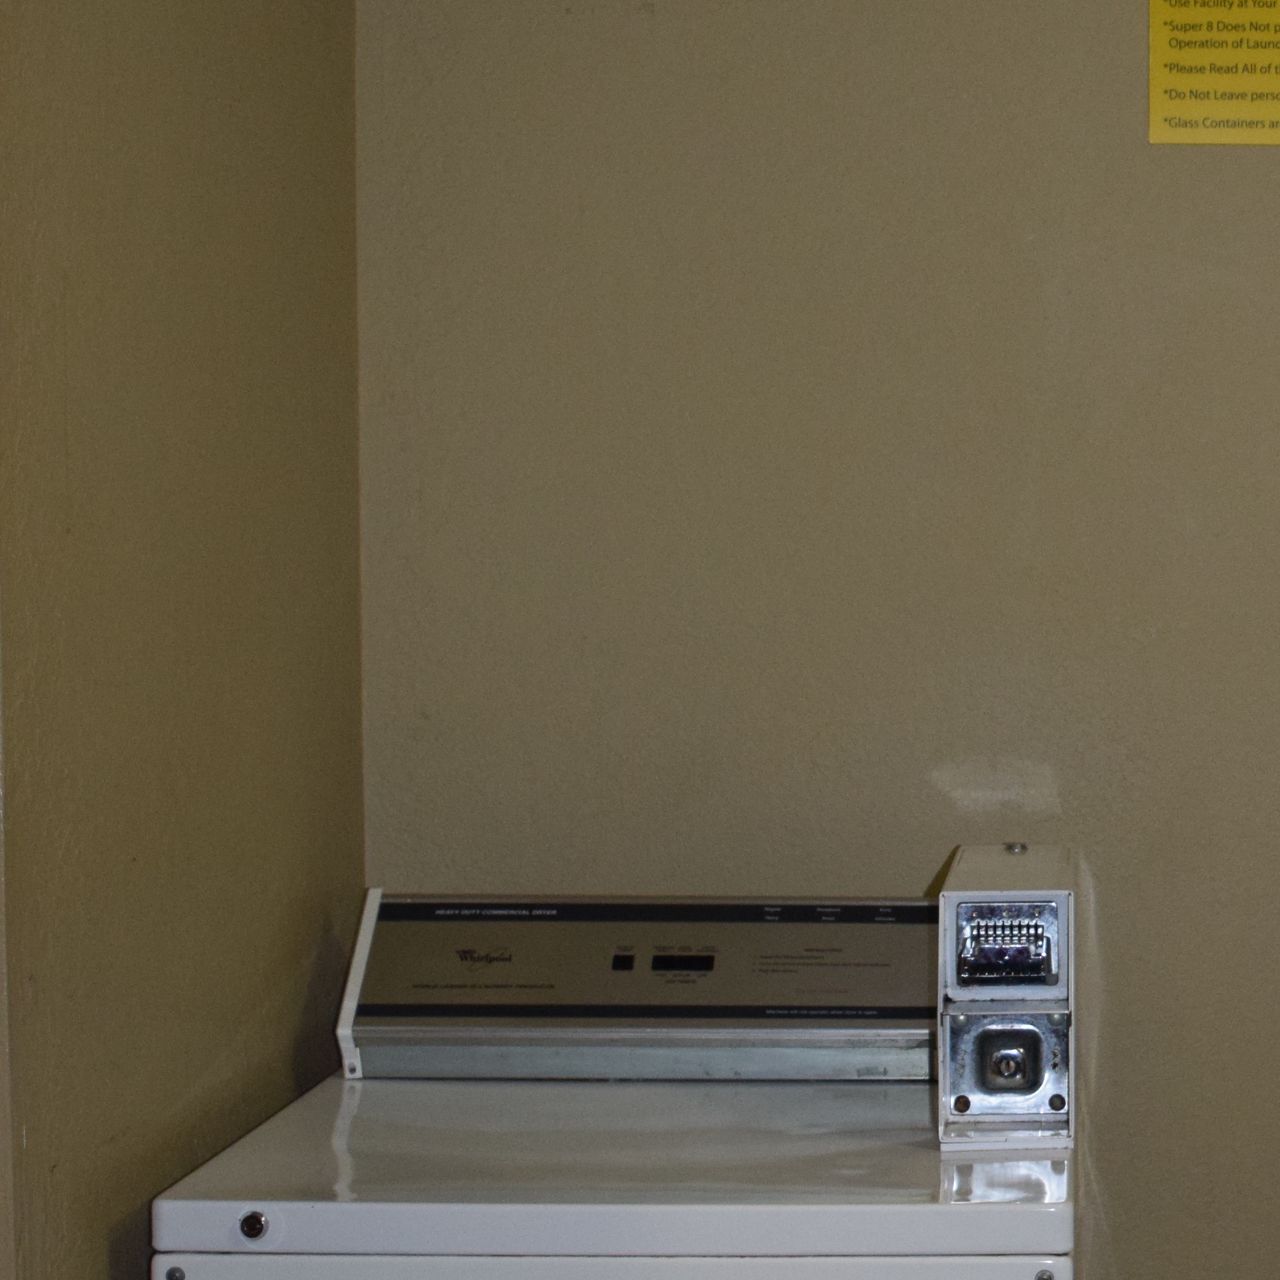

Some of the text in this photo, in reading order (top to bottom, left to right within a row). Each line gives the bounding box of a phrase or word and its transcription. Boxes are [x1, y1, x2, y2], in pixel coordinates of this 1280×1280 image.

[1205, 20, 1214, 32] 8
[1216, 20, 1247, 32] Does
[1248, 22, 1271, 33] Not
[1168, 38, 1229, 50] Operation
[1231, 37, 1244, 49] of
[1209, 62, 1239, 74] Read
[1241, 63, 1258, 75] All
[1259, 63, 1273, 75] of
[1188, 89, 1211, 101] Not
[1213, 90, 1249, 101] Leave
[1201, 118, 1266, 129] Containers
[456, 949, 512, 963] Whirlpool
